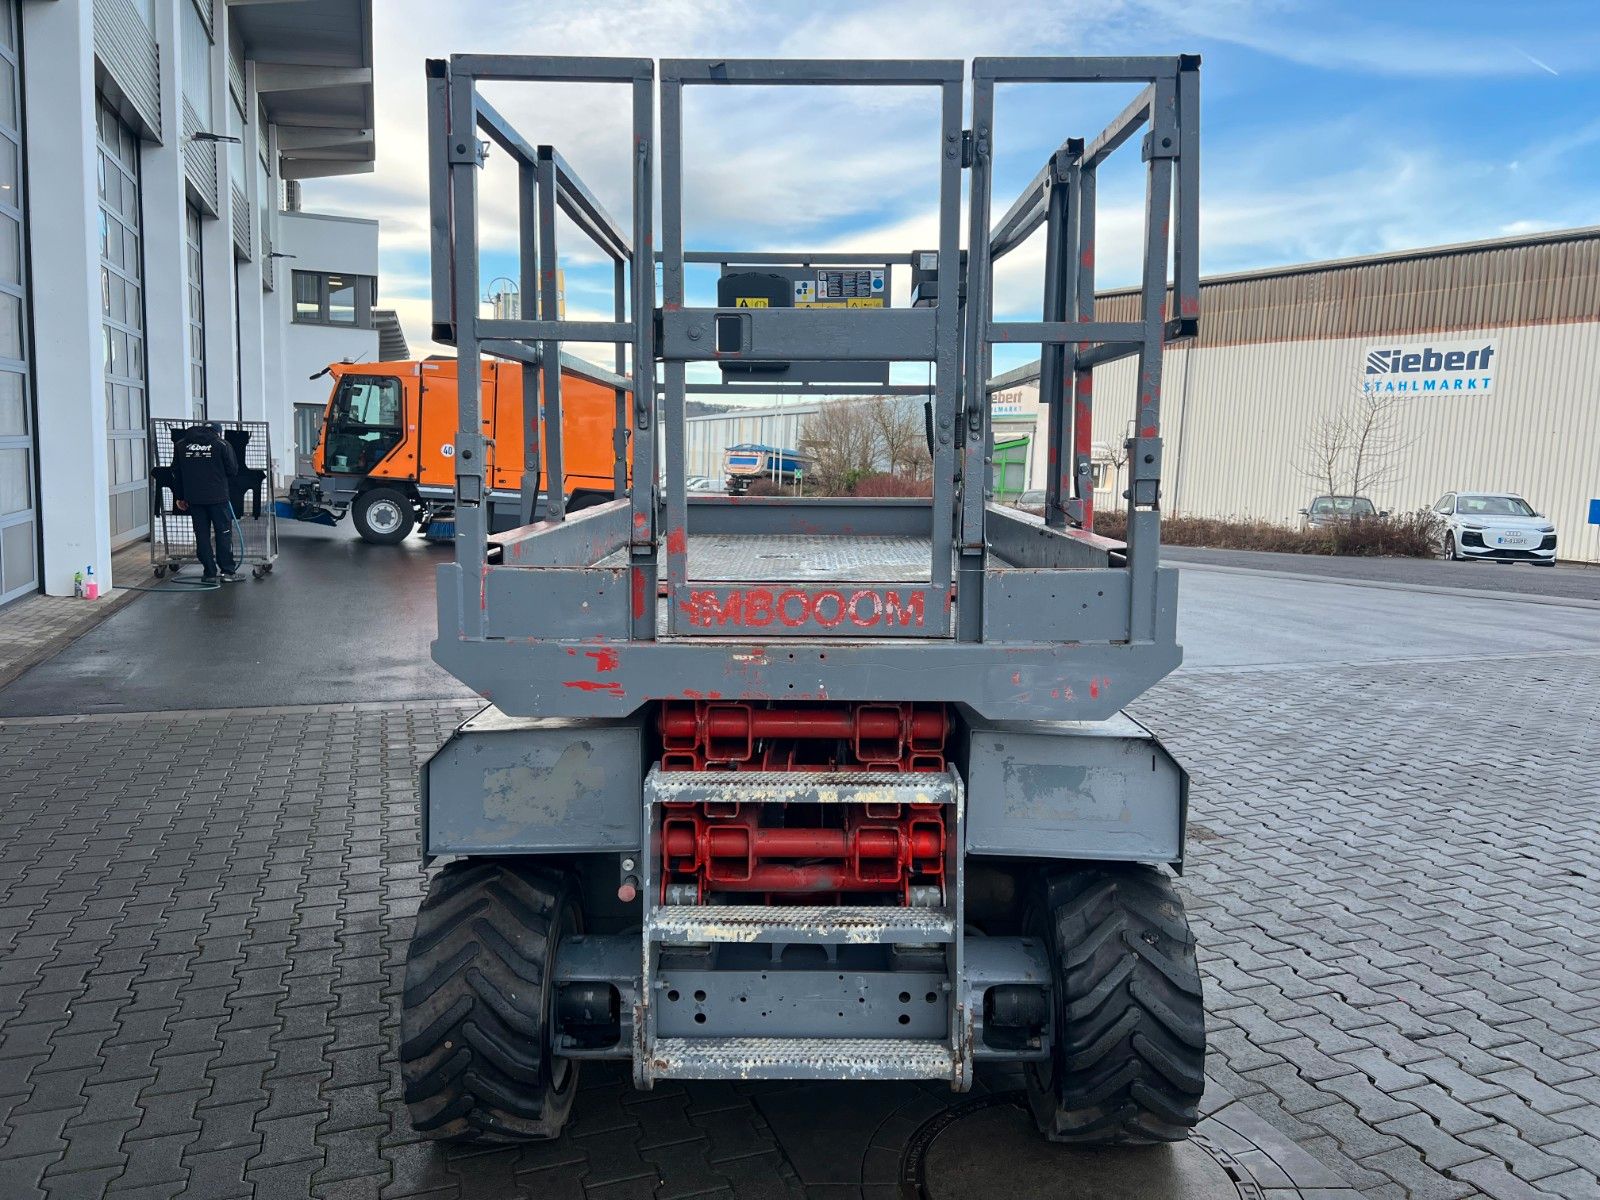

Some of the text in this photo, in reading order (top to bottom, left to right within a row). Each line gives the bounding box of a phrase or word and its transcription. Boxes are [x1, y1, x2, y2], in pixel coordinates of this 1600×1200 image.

[1366, 345, 1495, 374] Siebert
[1363, 378, 1491, 392] STAHLMARKT
[992, 391, 1022, 403] ebert
[443, 446, 453, 456] 40
